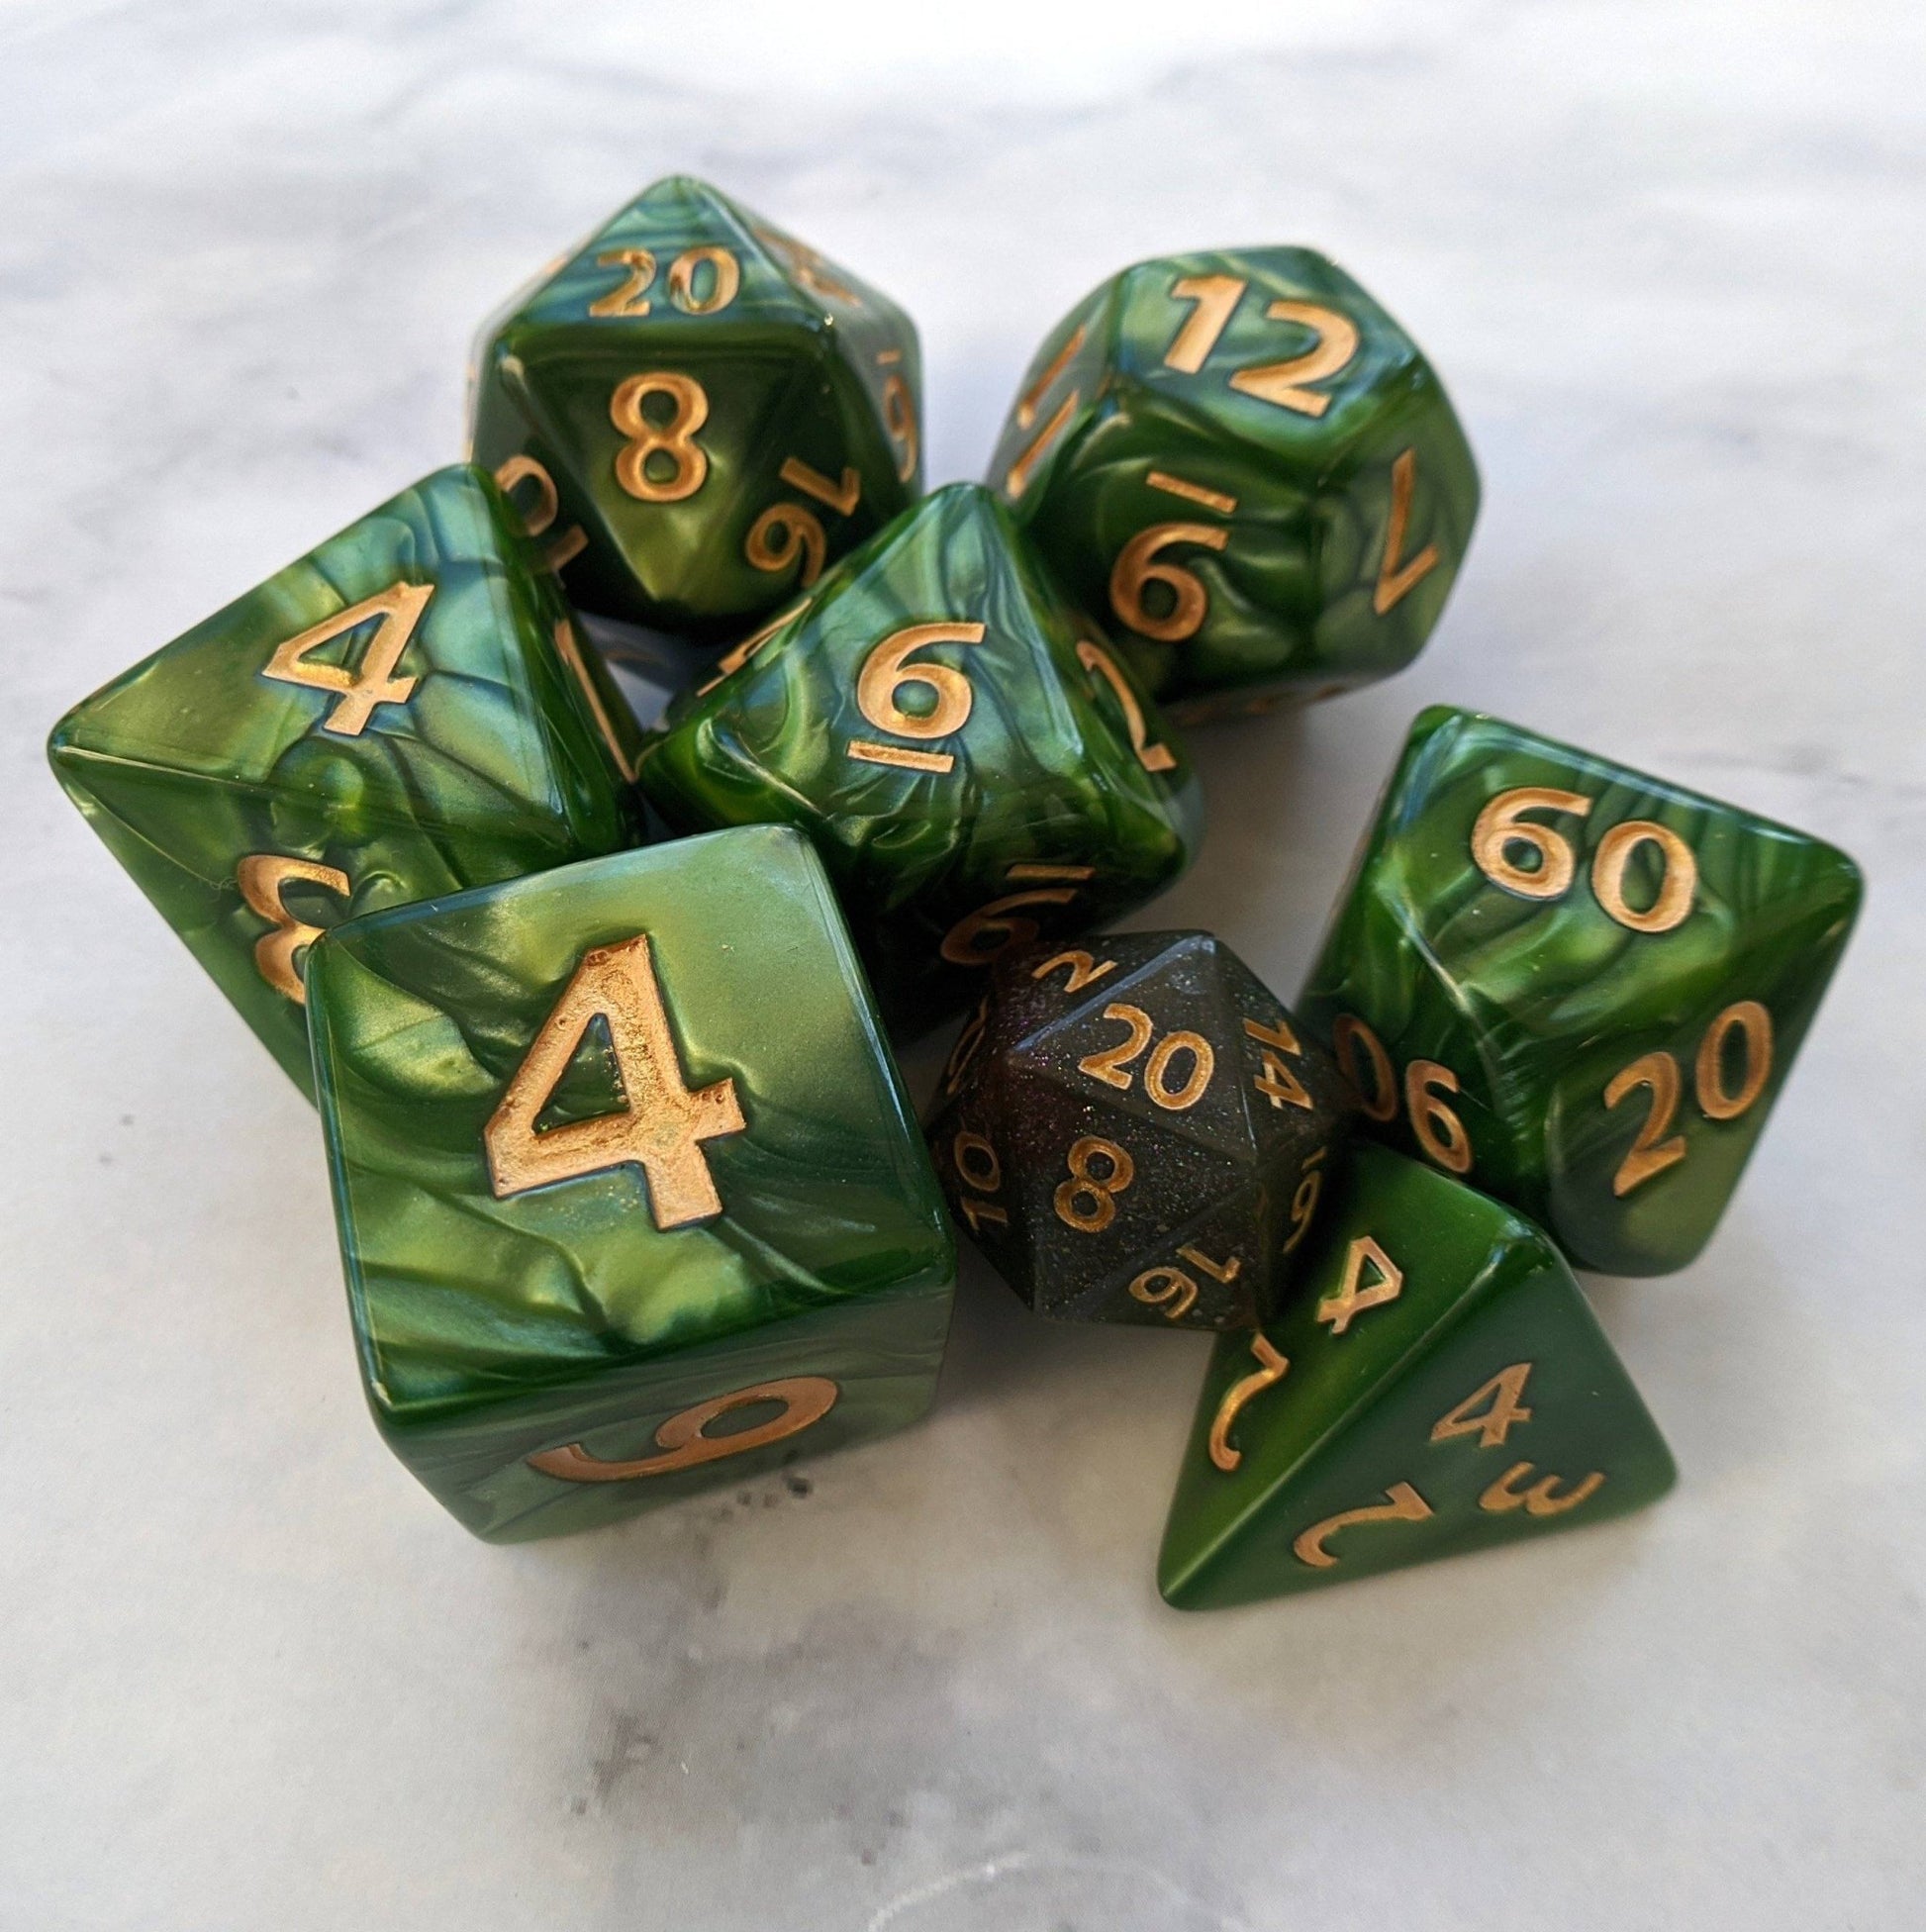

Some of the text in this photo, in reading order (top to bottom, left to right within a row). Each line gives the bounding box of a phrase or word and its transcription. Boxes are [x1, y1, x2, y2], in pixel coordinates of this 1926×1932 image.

[588, 246, 740, 318] 20
[1164, 274, 1360, 418] 12
[610, 371, 710, 502] 8
[261, 582, 434, 736] 4
[847, 622, 987, 774] 6
[1471, 787, 1698, 932] 60
[1031, 950, 1117, 993] 2
[484, 933, 747, 1231] 4
[1078, 1003, 1214, 1111] 20
[1243, 1017, 1313, 1111] 14
[1604, 1001, 1773, 1197] 20
[1053, 1135, 1134, 1233] 8
[1316, 1235, 1403, 1334] 4
[1430, 1362, 1533, 1449] 4
[1479, 1462, 1606, 1517] 3
